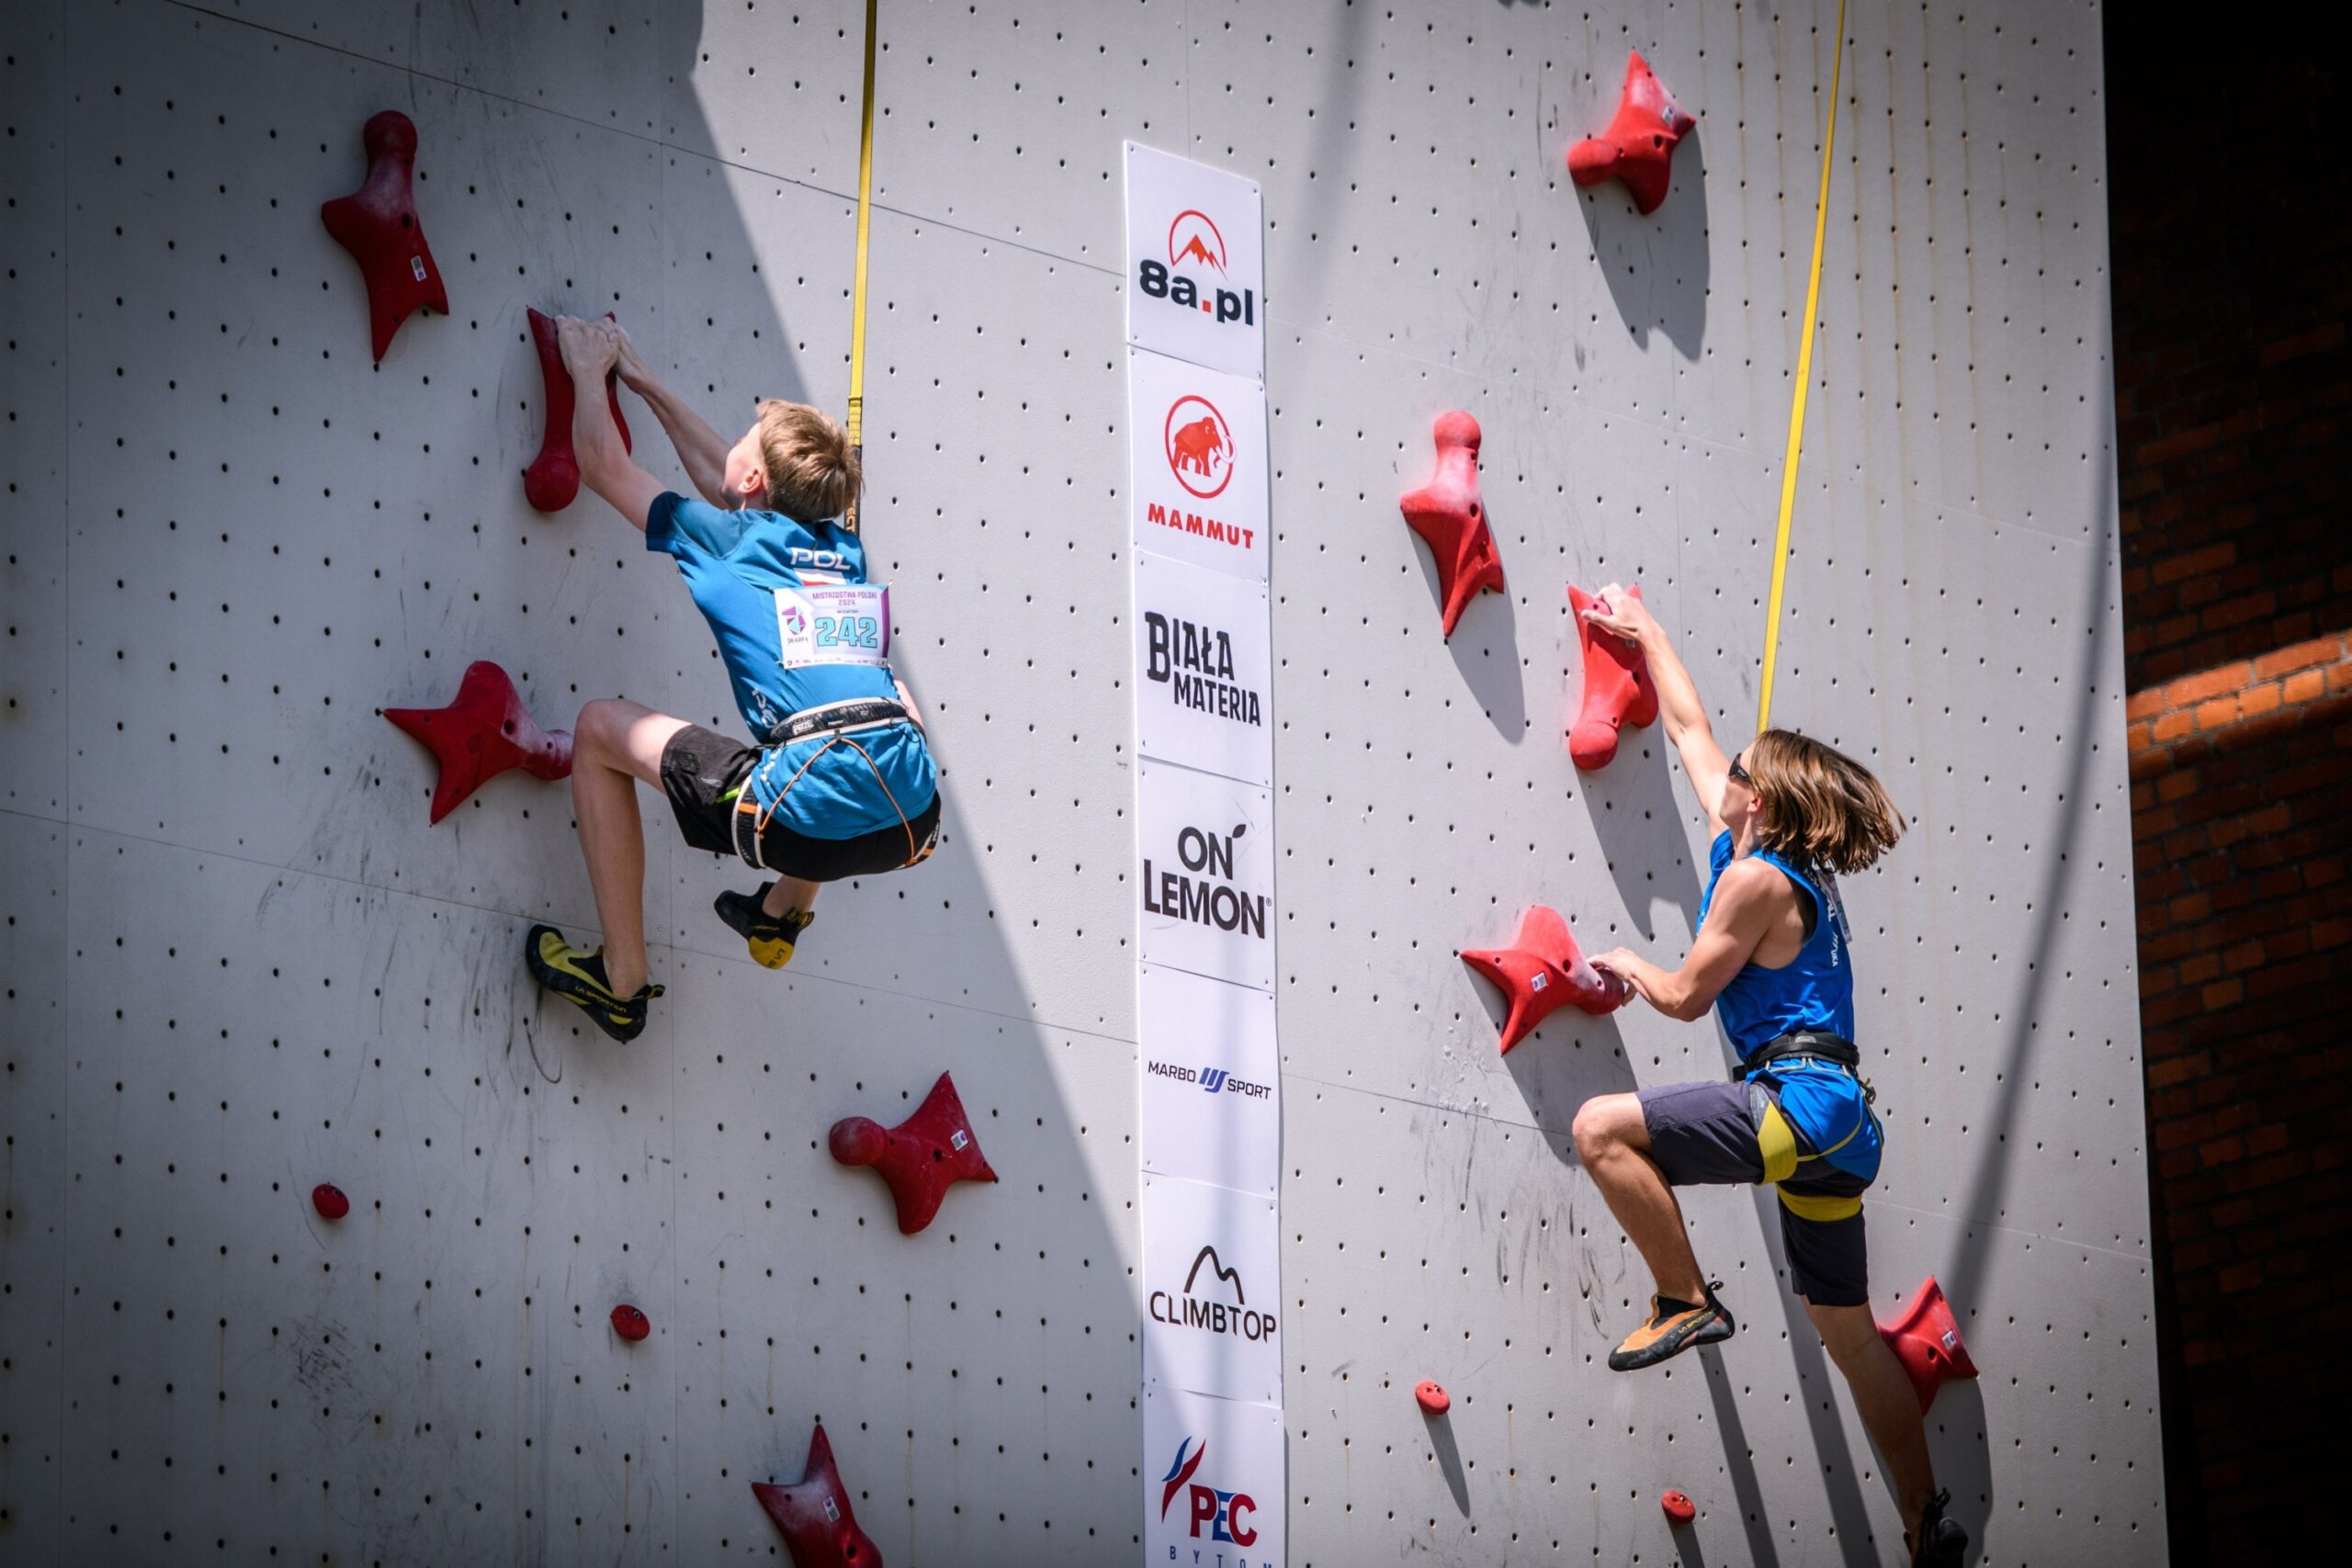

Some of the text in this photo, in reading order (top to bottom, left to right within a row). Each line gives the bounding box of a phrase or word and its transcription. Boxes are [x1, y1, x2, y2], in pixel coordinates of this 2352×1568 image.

[1139, 259, 1253, 326] 8a.pl
[1148, 502, 1254, 549] MAMMUT
[790, 547, 851, 570] POL
[858, 591, 877, 599] POLSKI
[814, 616, 878, 649] 242
[1145, 610, 1235, 683] BIAŁA
[1173, 674, 1261, 727] MATERIA
[1177, 826, 1234, 881] ON
[1148, 1059, 1272, 1100] MARBO SPORT
[1149, 1291, 1277, 1344] CLIMBTOP
[1189, 1483, 1258, 1548] PEC
